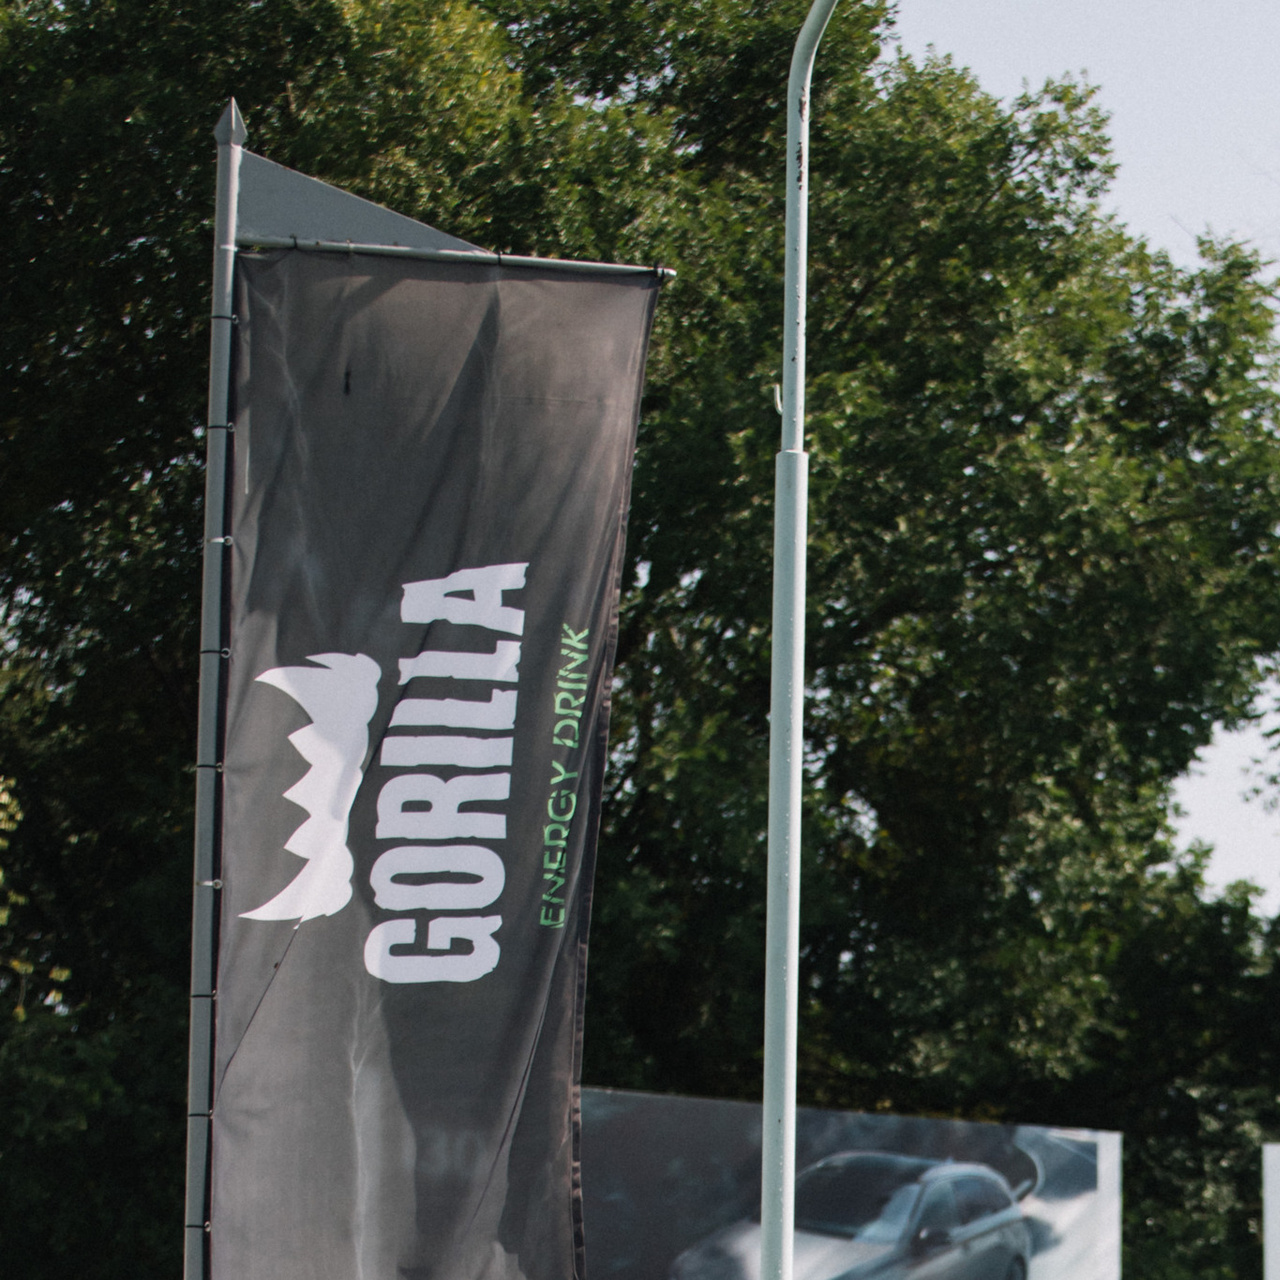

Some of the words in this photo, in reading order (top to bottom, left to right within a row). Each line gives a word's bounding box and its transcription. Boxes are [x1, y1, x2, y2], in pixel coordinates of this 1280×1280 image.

[552, 623, 591, 749] DRINK
[364, 562, 530, 984] GORILLA
[538, 760, 579, 930] ENERGY
